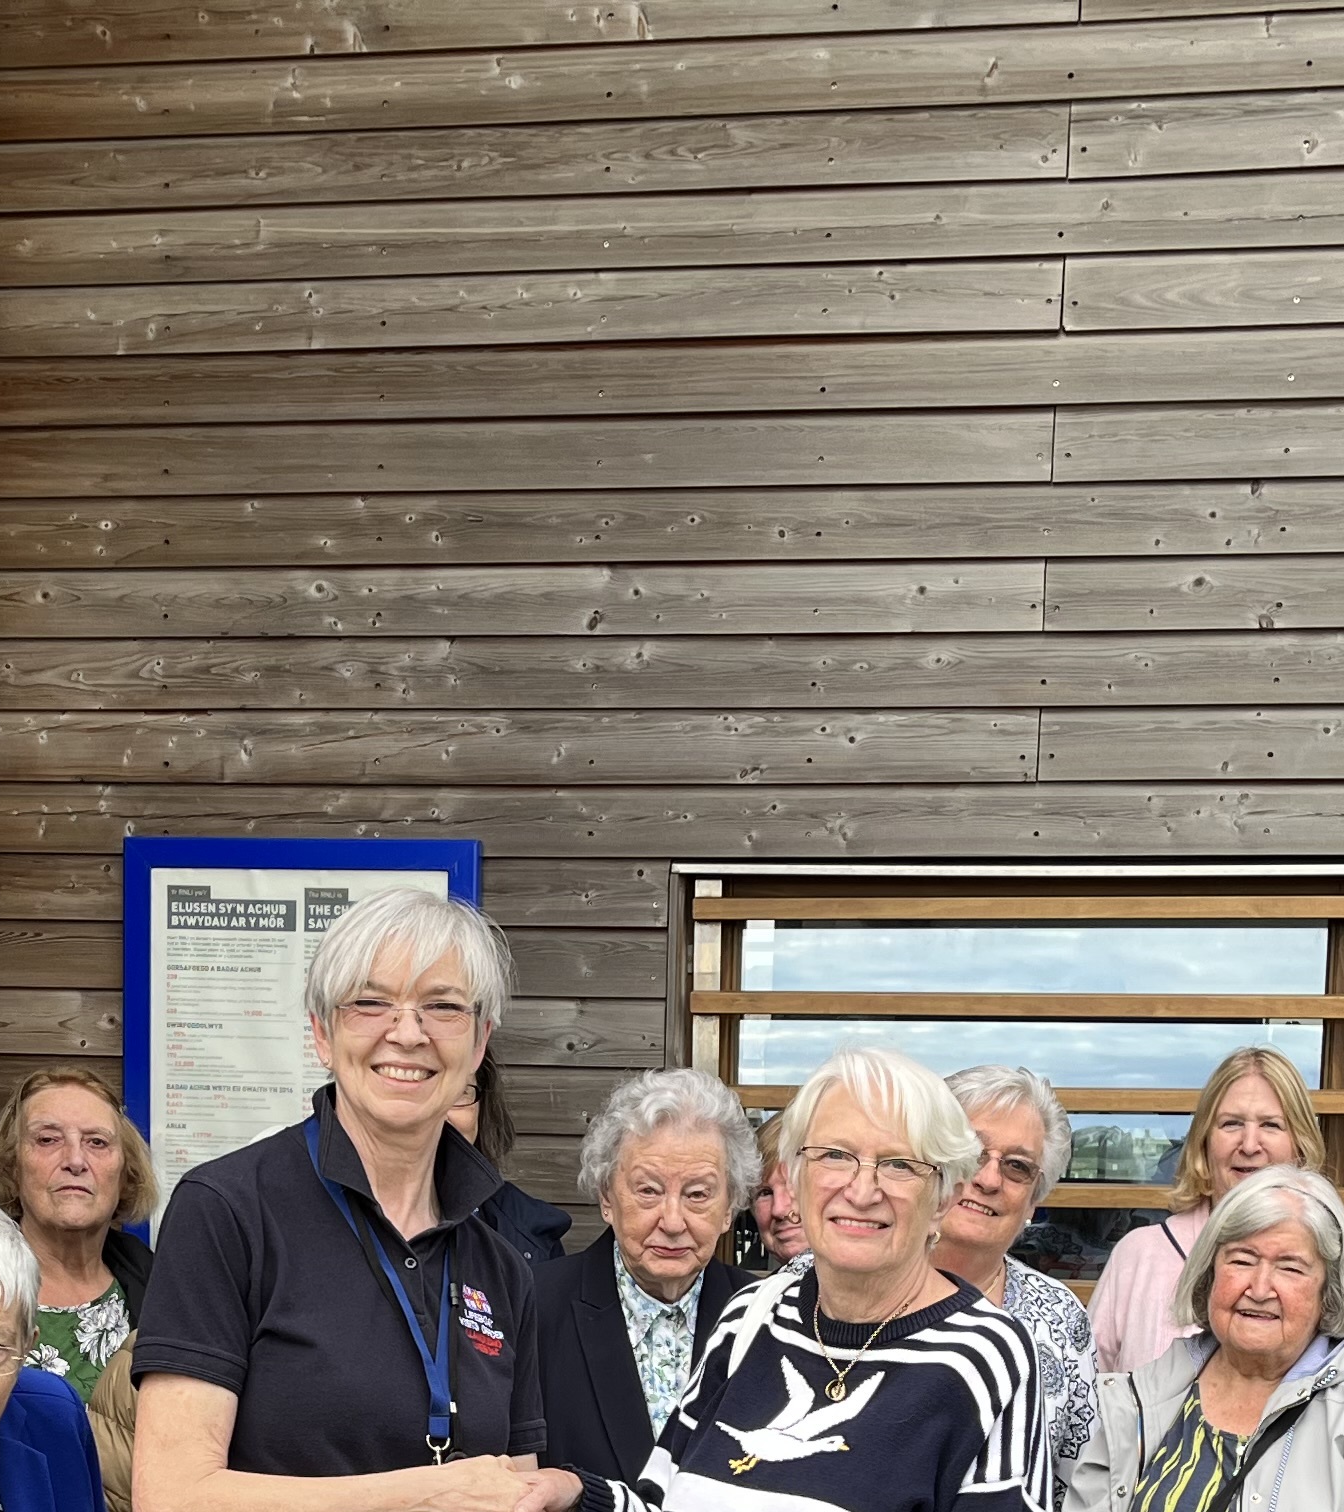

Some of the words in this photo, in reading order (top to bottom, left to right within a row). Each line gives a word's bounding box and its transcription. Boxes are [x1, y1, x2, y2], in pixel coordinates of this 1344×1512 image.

[171, 901, 216, 913] ELUSEN
[247, 904, 287, 915] ACHUB
[308, 904, 332, 916] THE
[171, 915, 228, 927] BYWYDAU
[230, 917, 247, 927] AR
[248, 917, 256, 928] Y
[258, 914, 285, 928] MÔR
